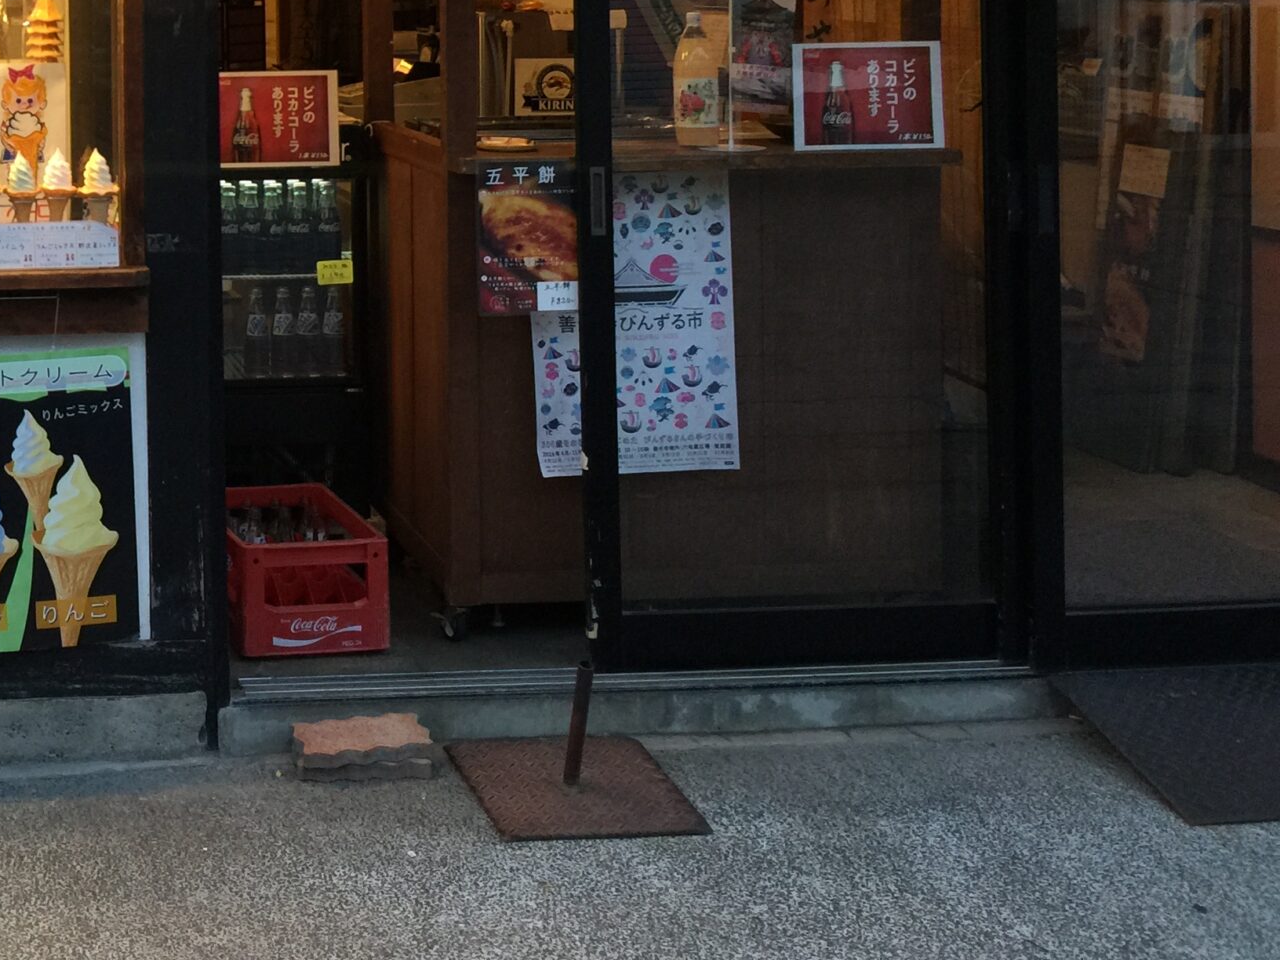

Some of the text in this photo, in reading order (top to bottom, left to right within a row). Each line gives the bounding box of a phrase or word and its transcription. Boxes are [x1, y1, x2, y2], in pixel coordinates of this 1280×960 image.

[866, 59, 882, 117] あります
[903, 58, 917, 101] ビンの
[271, 86, 285, 138] あります
[303, 85, 316, 123] ビンの
[538, 100, 574, 111] KIRIN
[485, 165, 556, 185] 五平餅
[41, 397, 124, 422] りんごミックス
[41, 600, 111, 624] りんご
[290, 615, 339, 634] Coca-Cola
